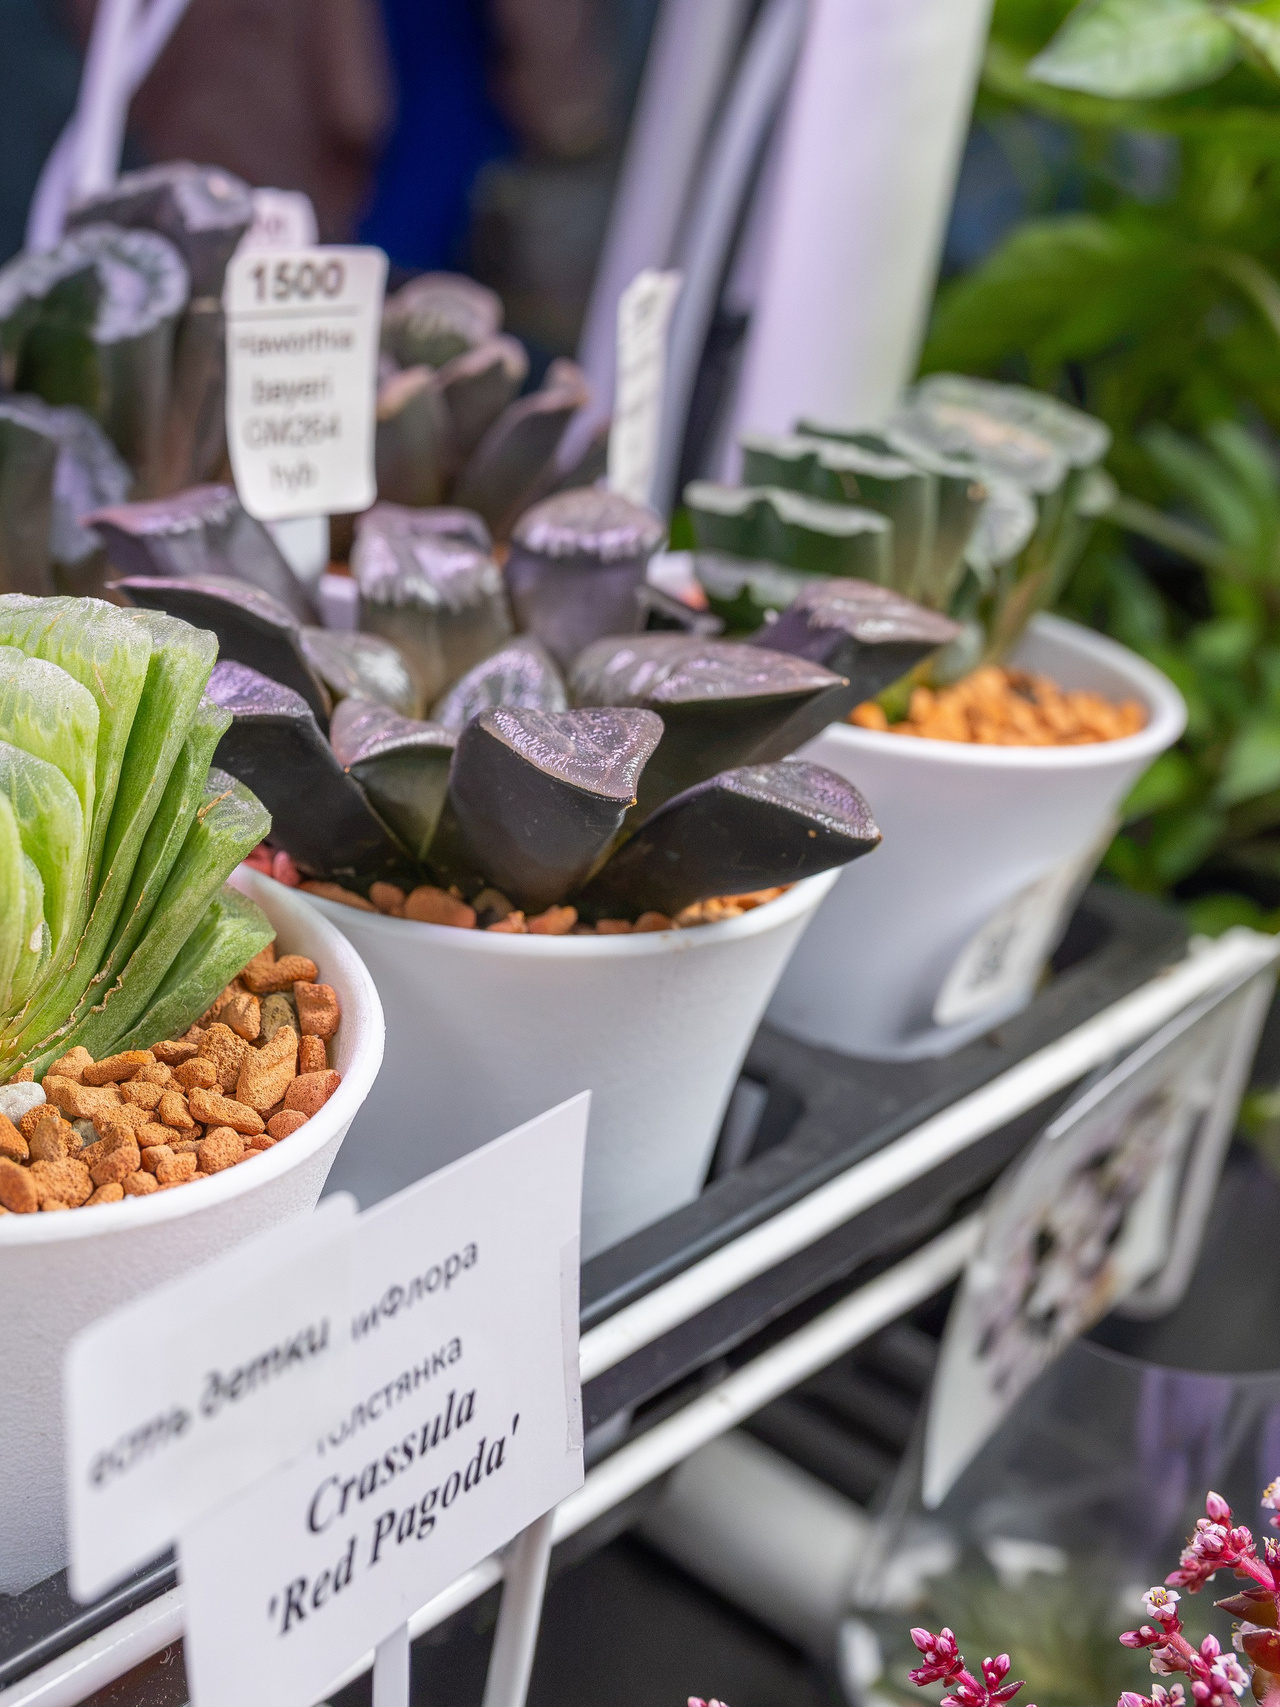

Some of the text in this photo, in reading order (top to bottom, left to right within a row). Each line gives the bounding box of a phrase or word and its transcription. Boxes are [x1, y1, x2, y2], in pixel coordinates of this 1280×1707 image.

[250, 258, 346, 301] 1500
[237, 328, 356, 355] Haworthia
[306, 1387, 477, 1536] Crassula
[268, 1412, 521, 1638] 'Red Pagoda'
